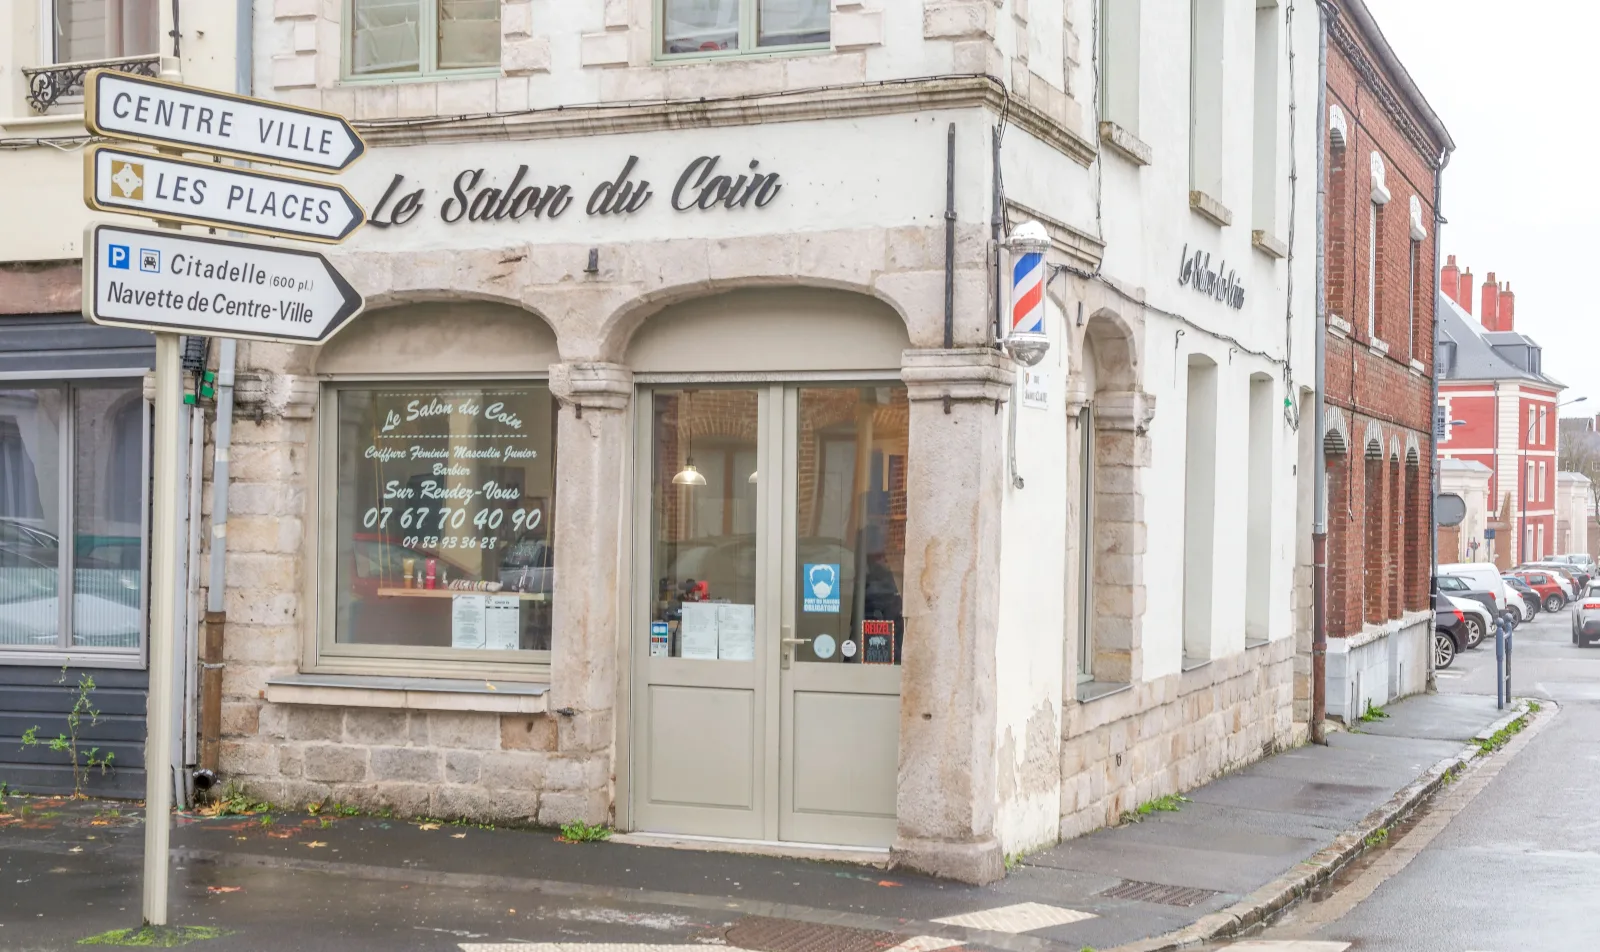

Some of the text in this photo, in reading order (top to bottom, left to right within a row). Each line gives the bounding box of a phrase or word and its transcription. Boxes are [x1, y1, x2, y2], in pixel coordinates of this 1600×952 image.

[112, 91, 333, 155] CENTRE VILLE
[155, 172, 332, 225] LES PLACES
[368, 155, 782, 228] Le Salon du Coin
[112, 247, 126, 266] P
[170, 253, 266, 285] Citadelle
[269, 274, 295, 289] (600
[107, 281, 313, 324] Navette de Centre-Ville
[381, 398, 522, 432] Le Salon du Coin
[364, 445, 538, 462] Coiffure Féminin Masculin Junior
[432, 462, 471, 476] Barbier
[383, 480, 520, 505] Sur Rendez-Vous
[363, 507, 541, 532] 07 67 70 40 90
[402, 535, 498, 550] 09 83 93 36 28
[865, 622, 890, 634] REUZEL
